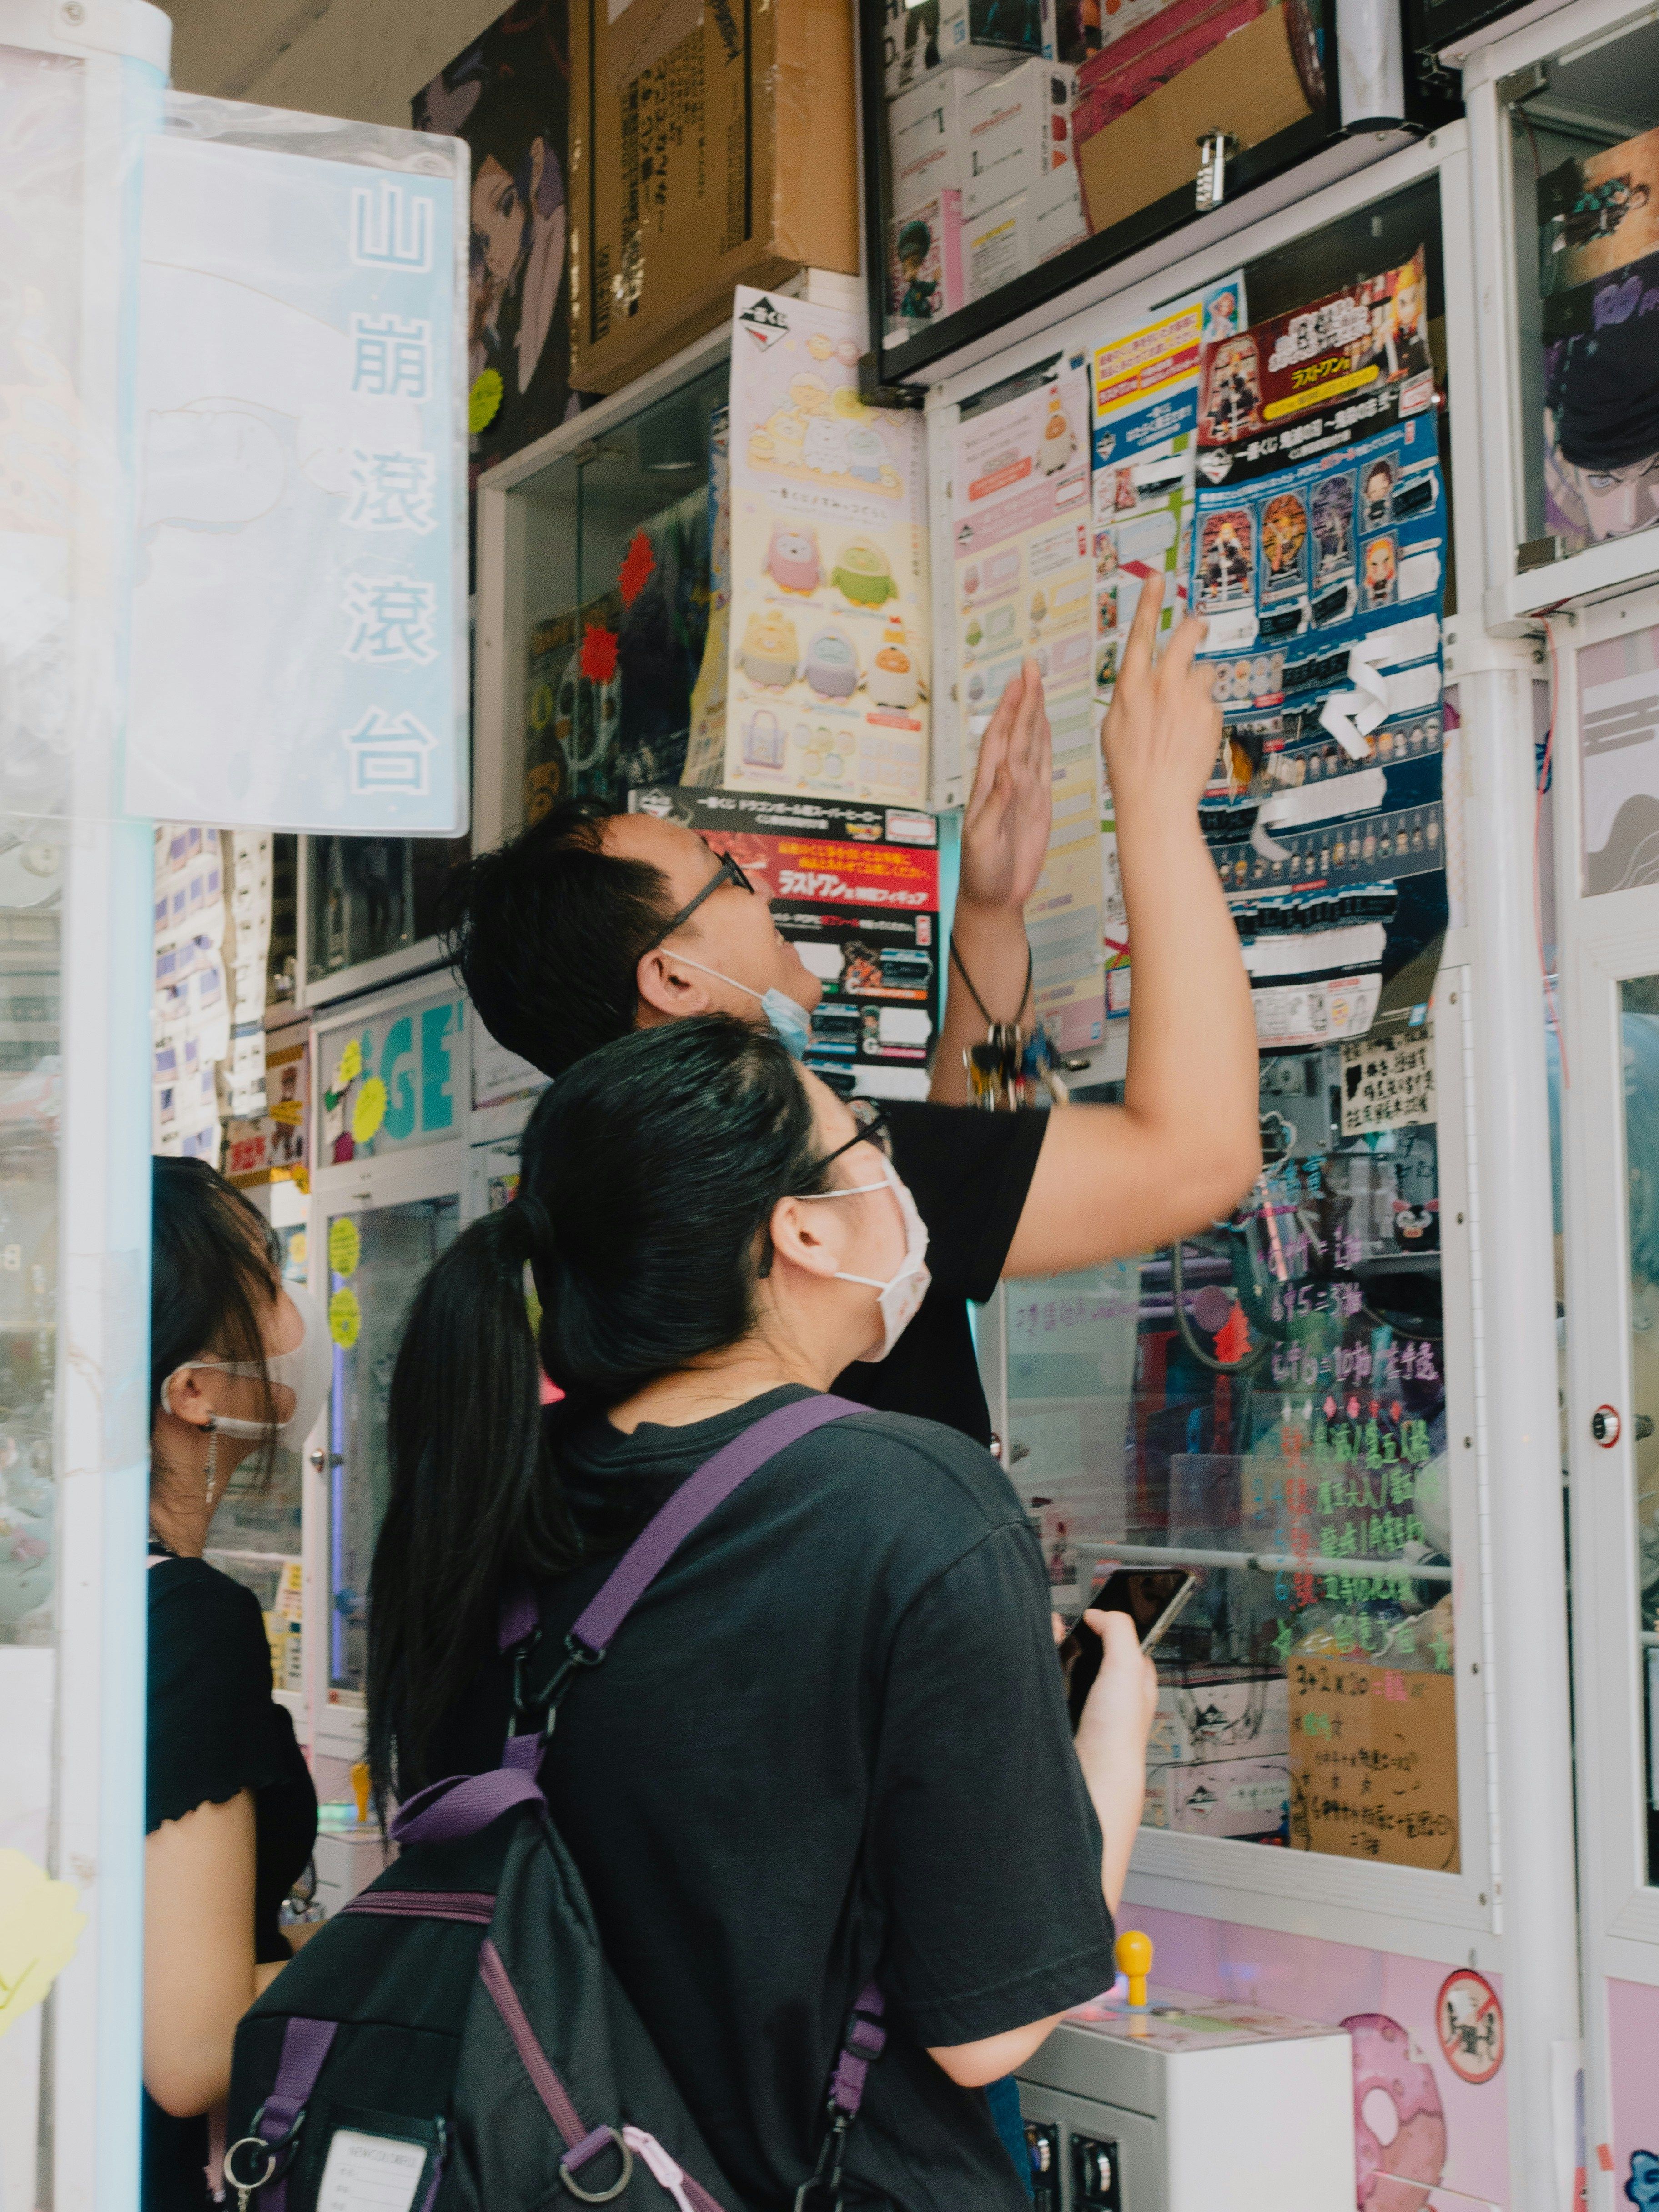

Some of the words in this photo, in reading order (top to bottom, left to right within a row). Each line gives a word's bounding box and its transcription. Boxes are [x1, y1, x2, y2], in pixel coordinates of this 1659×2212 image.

[342, 182, 439, 795] 山崩滾滾台
